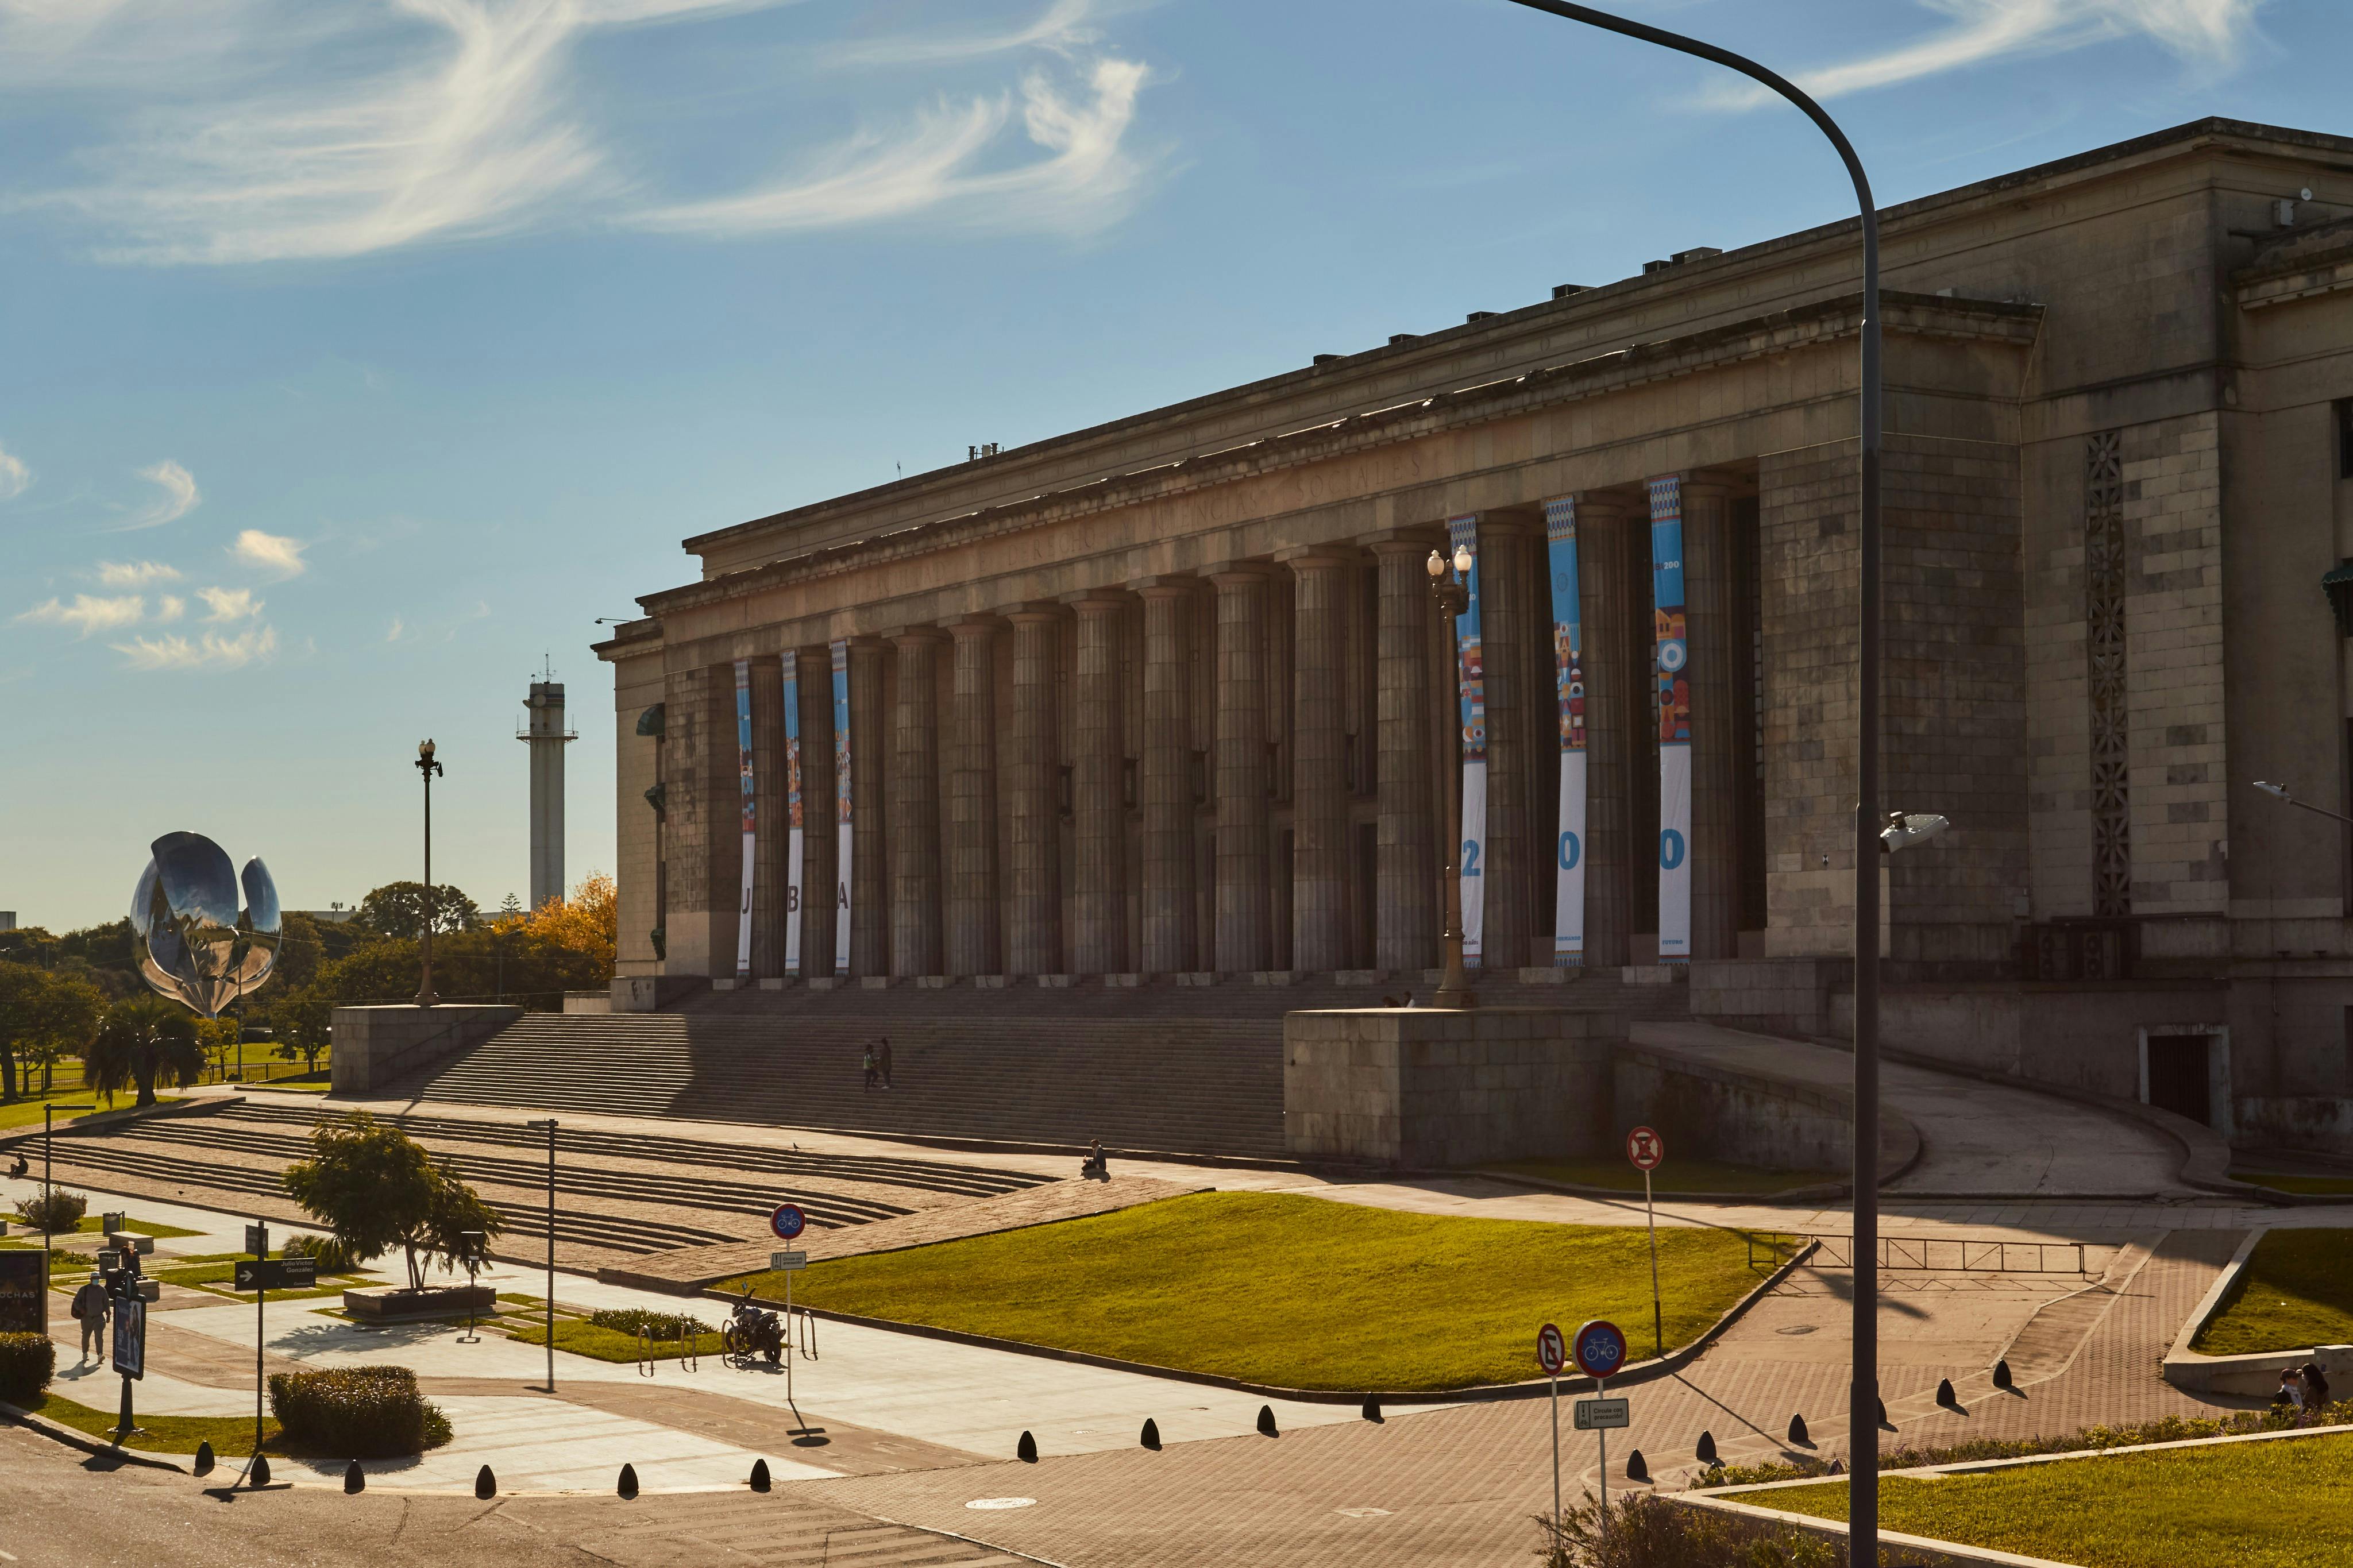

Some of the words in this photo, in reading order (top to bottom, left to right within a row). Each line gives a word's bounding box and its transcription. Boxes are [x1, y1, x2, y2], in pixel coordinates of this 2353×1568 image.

[1008, 527, 1095, 566] DERECHO
[1296, 452, 1420, 502] SOCIALES
[1462, 840, 1480, 876] 2
[1559, 831, 1580, 870] 0
[742, 887, 750, 914] U
[788, 885, 799, 912] B
[837, 882, 848, 910] A
